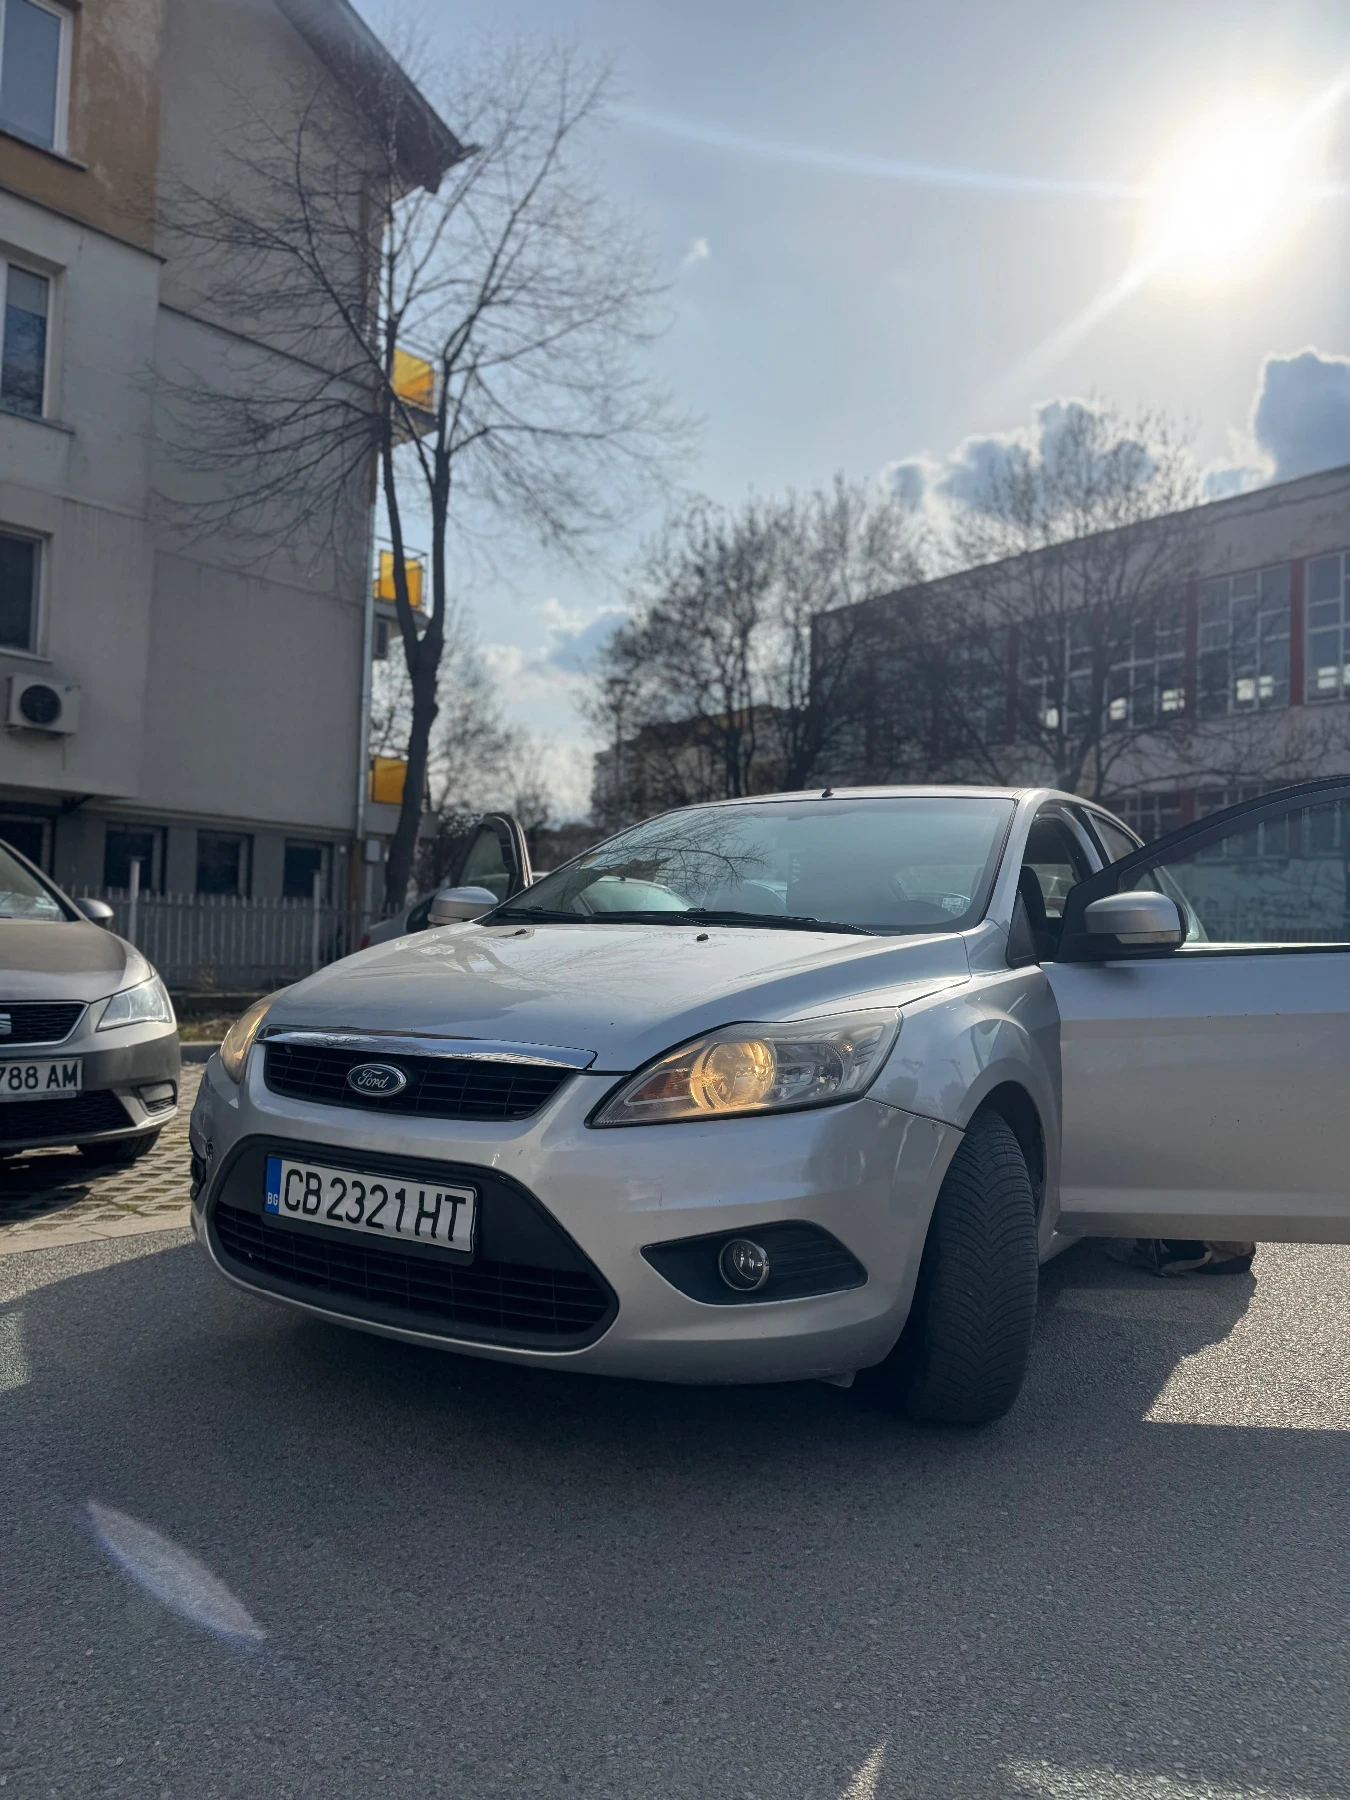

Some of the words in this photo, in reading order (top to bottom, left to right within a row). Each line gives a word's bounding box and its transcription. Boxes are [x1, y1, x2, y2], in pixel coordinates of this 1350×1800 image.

[46, 1062, 77, 1089] AM
[357, 1069, 389, 1089] Ford
[267, 1191, 279, 1206] BG
